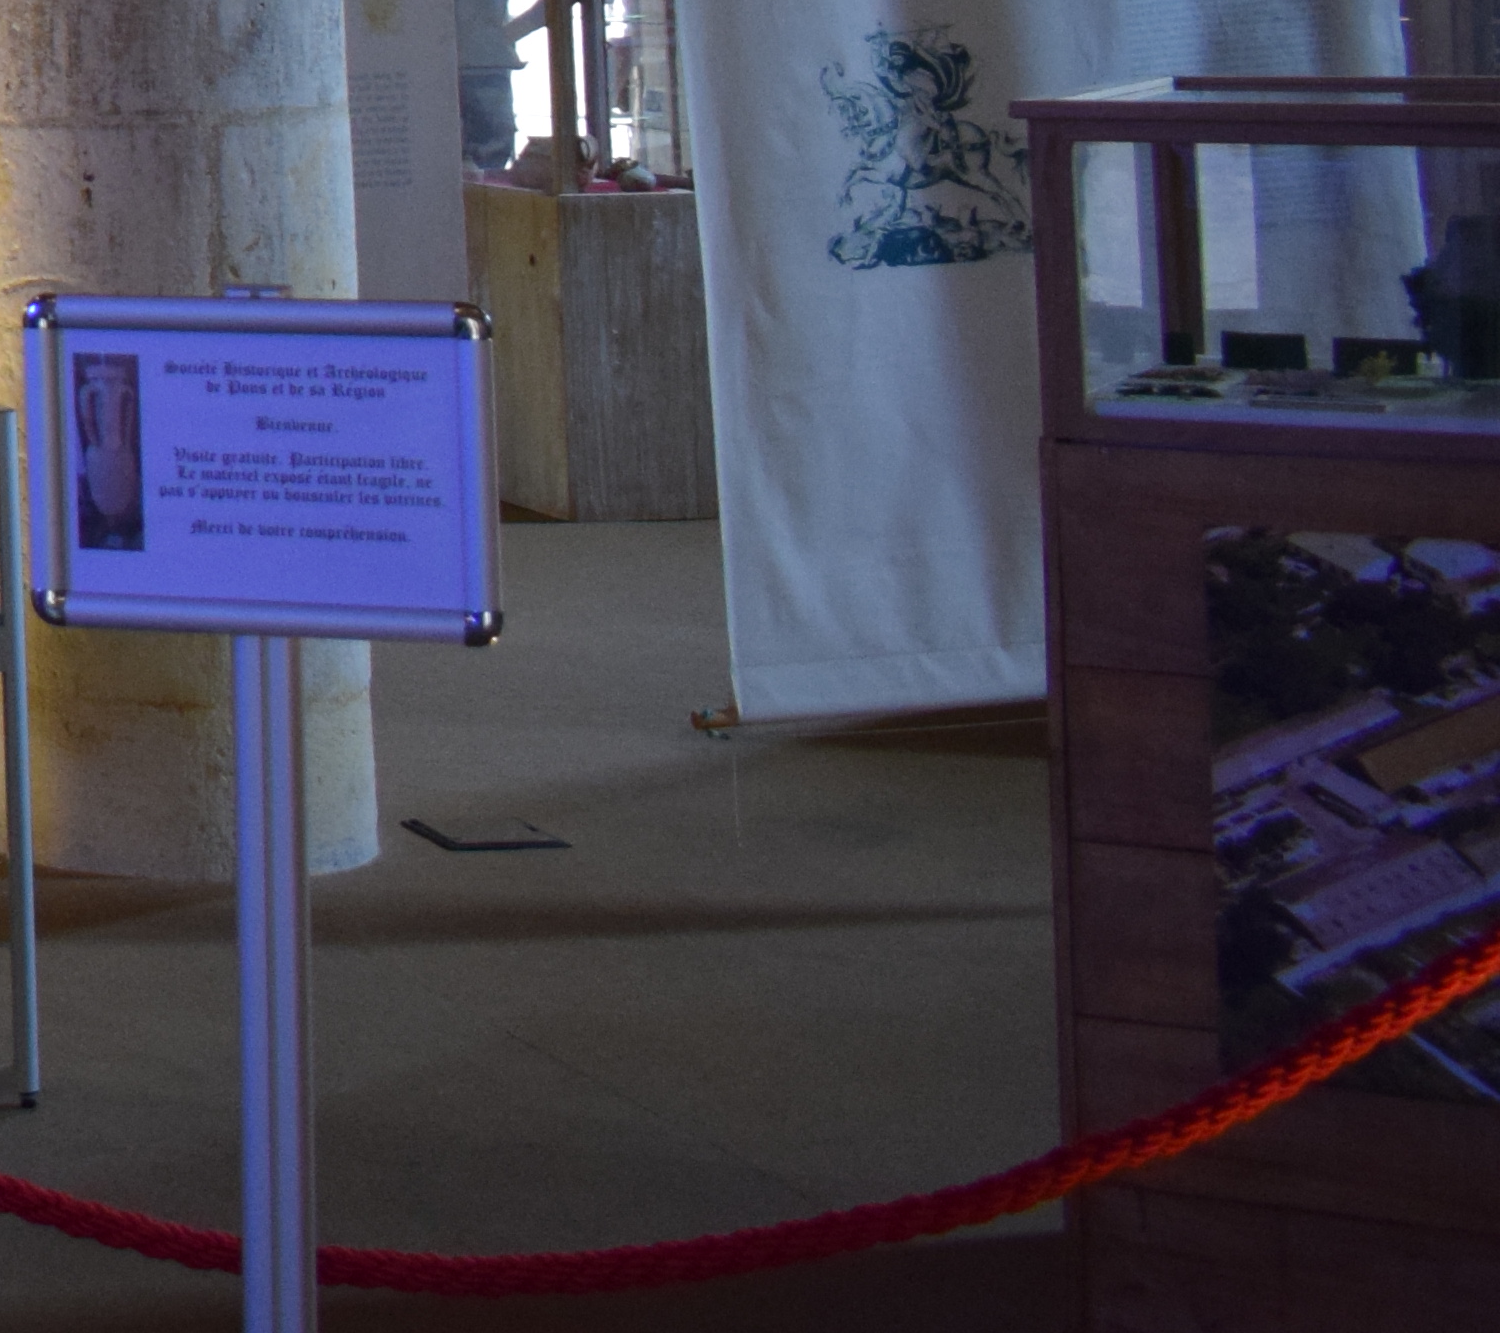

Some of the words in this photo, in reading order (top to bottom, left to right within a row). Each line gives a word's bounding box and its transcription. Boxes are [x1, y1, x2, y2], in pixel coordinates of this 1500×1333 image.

[164, 360, 217, 375] Société
[223, 361, 301, 380] Historique
[307, 367, 318, 378] et
[324, 364, 428, 383] Archéologique
[206, 380, 221, 394] de
[227, 381, 267, 397] Pons
[272, 382, 284, 395] et
[289, 382, 304, 395] de
[309, 385, 325, 397] sa
[331, 382, 386, 400] Région
[173, 446, 217, 463] Visite
[222, 450, 283, 465] gratuite.
[289, 451, 386, 470] Participation
[390, 455, 430, 471] libre.
[177, 465, 197, 479] Le
[200, 466, 258, 482] matériel
[263, 468, 312, 487] exposé
[317, 468, 352, 485] étant
[357, 473, 410, 490] fragile,
[415, 478, 433, 489] ne
[159, 485, 184, 499] pas
[188, 484, 257, 502] s'appuyer
[263, 489, 279, 501] ou
[284, 487, 353, 504] bousculer
[358, 489, 380, 504] les
[190, 519, 234, 536] Merci
[237, 521, 254, 536] de
[257, 524, 295, 538] votre
[299, 525, 412, 543] compréhension.
